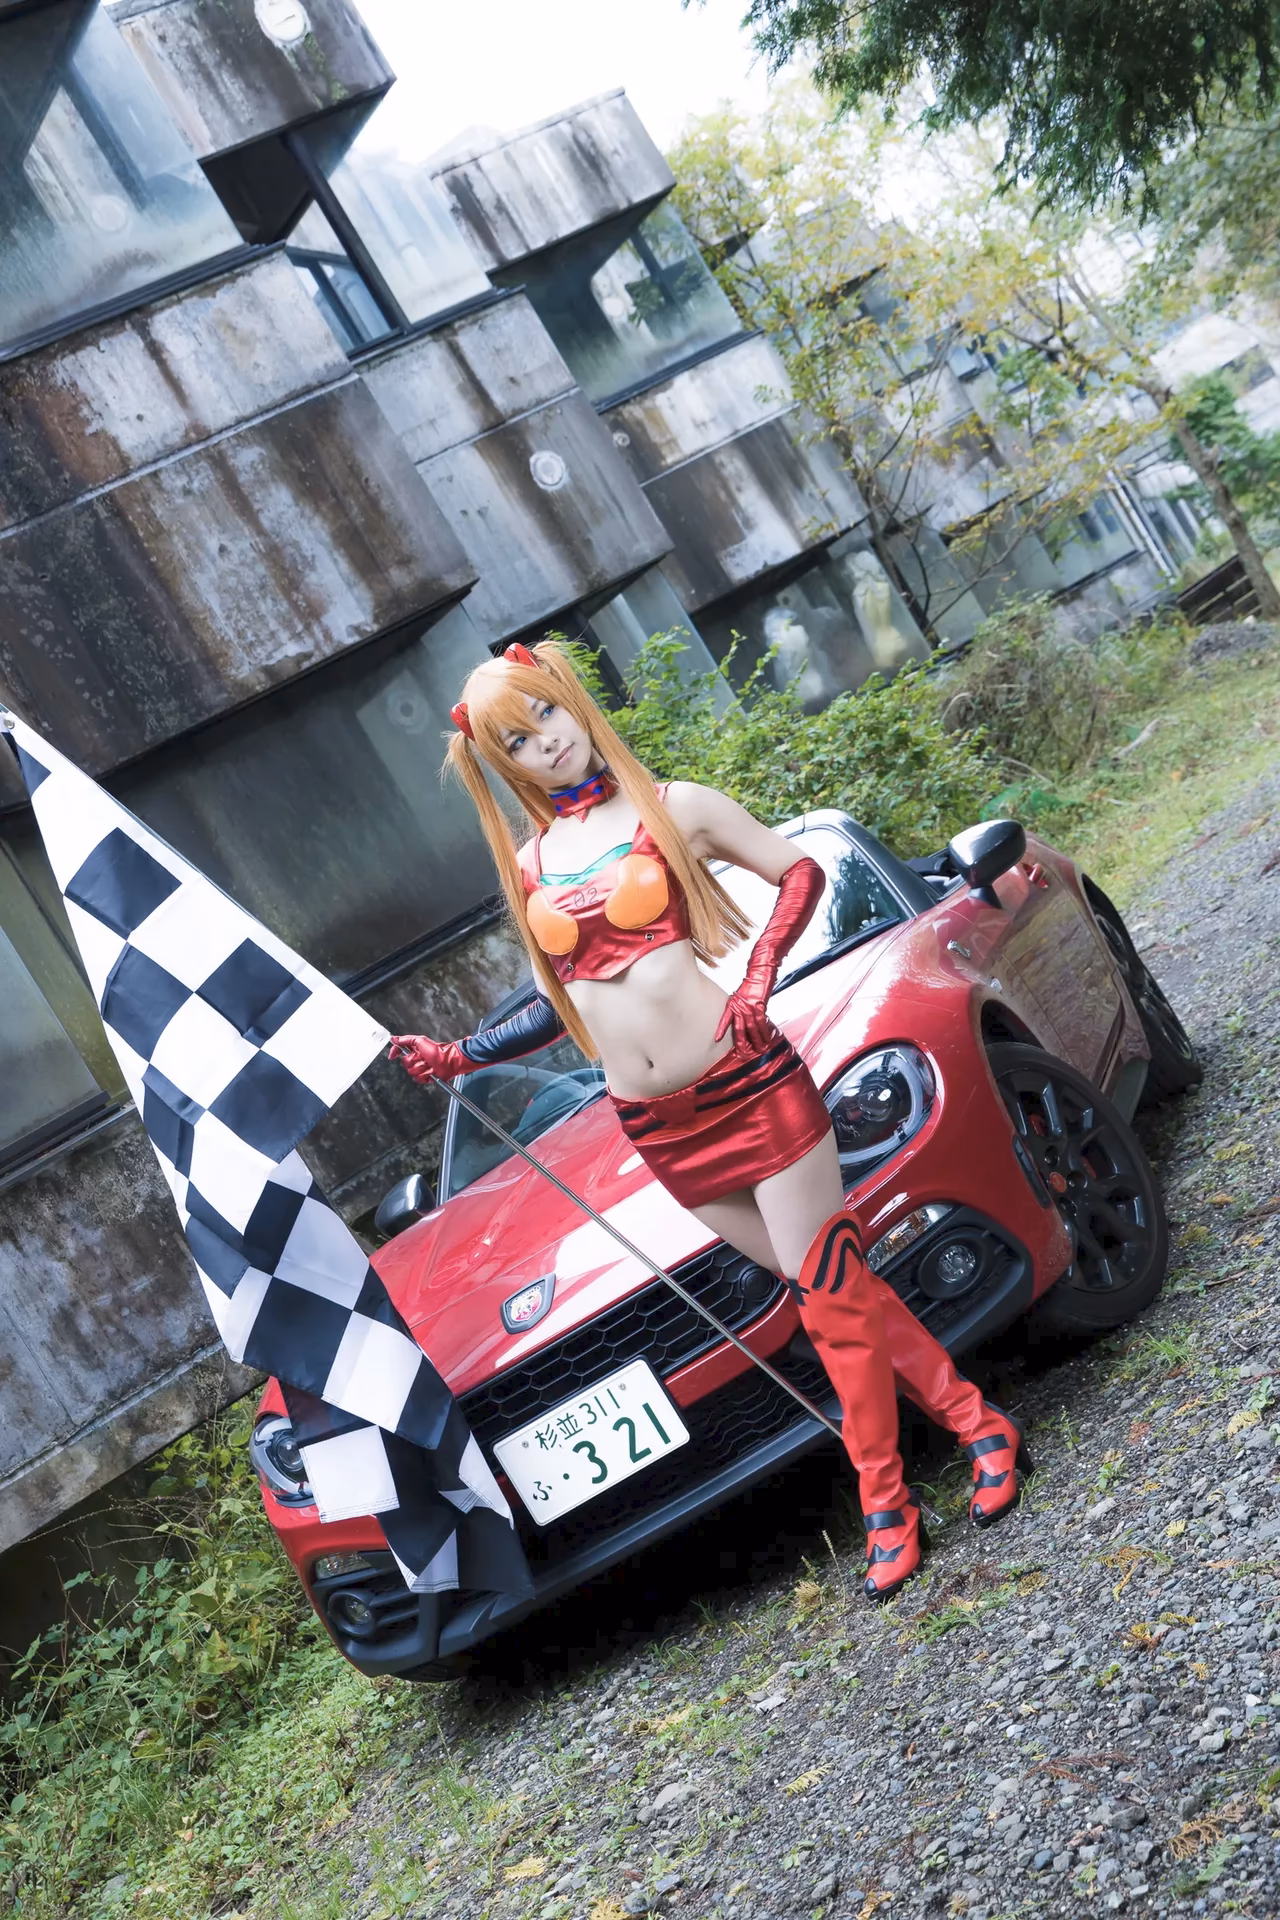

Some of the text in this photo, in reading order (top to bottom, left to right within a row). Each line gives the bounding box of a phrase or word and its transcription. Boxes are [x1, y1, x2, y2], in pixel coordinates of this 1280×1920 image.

[574, 887, 598, 908] 02
[535, 1389, 620, 1450] 杉並 311
[533, 1481, 552, 1501] ふ
